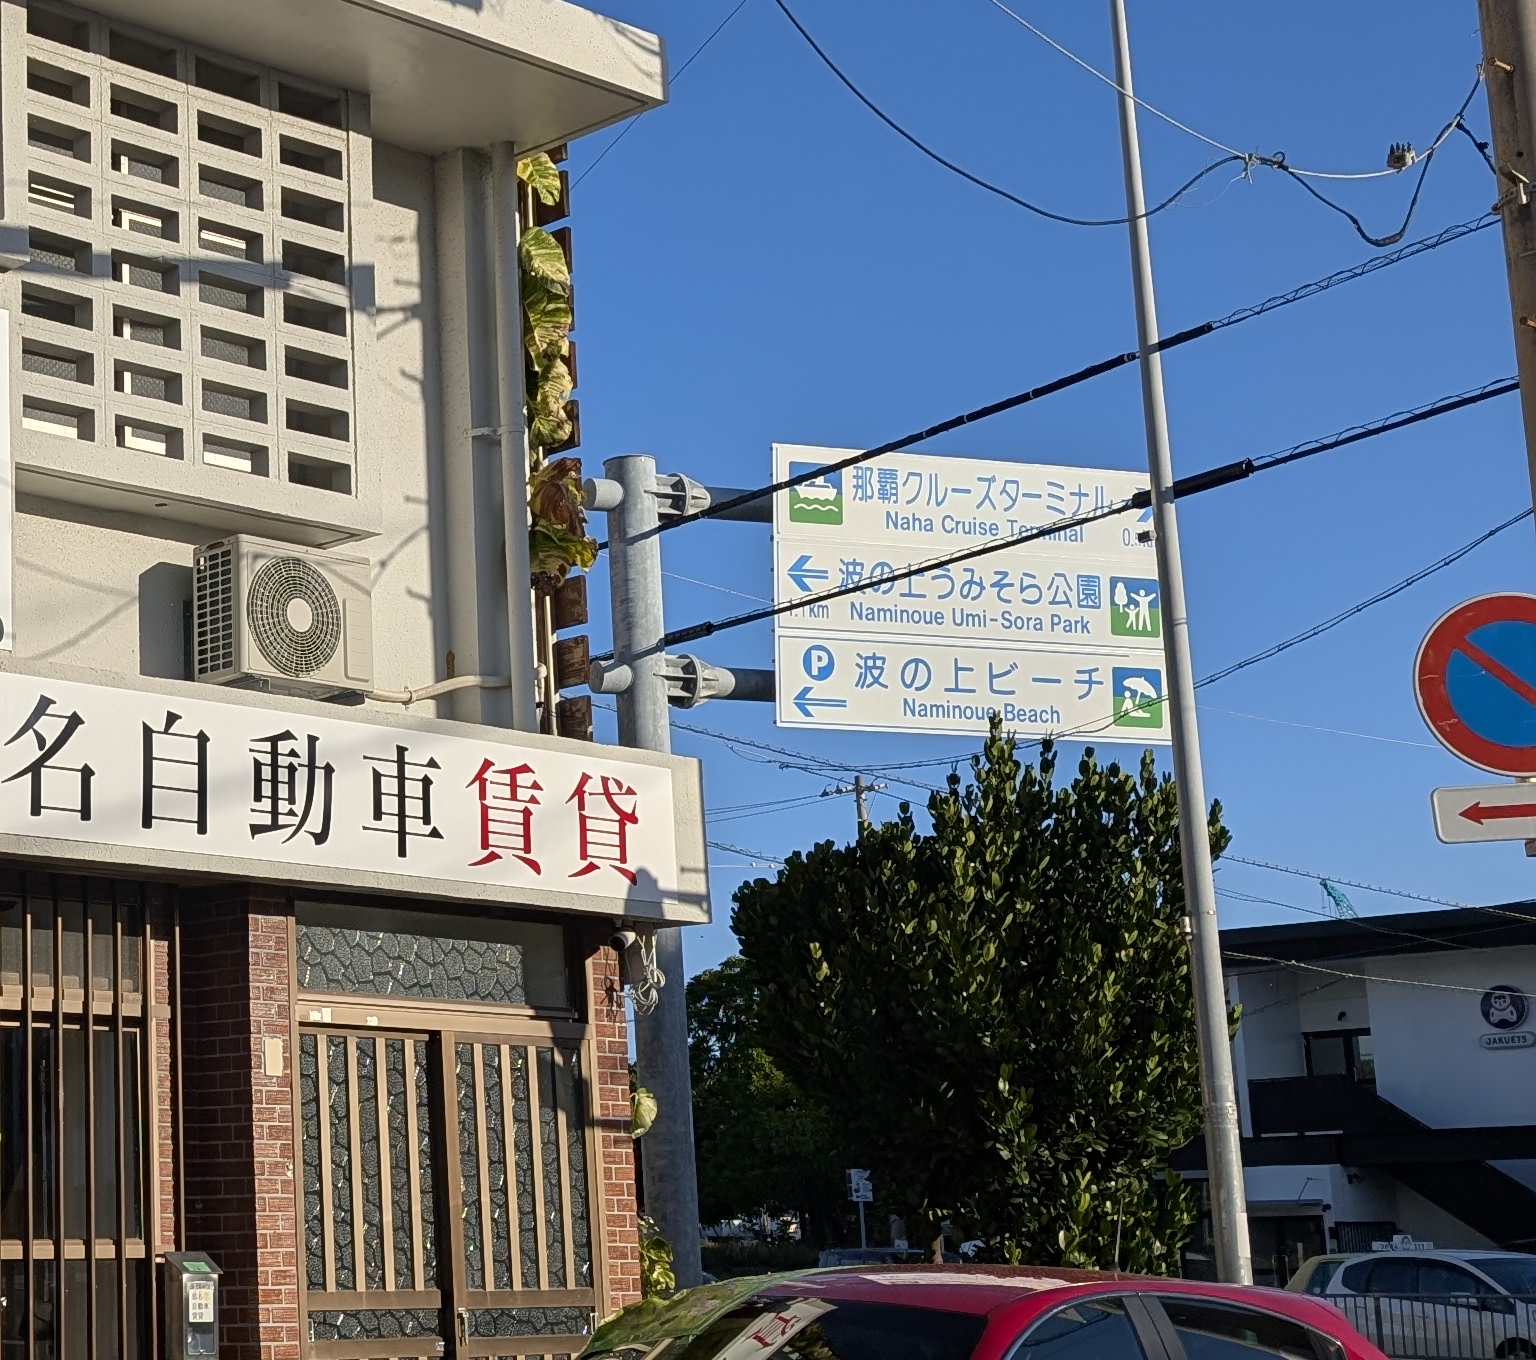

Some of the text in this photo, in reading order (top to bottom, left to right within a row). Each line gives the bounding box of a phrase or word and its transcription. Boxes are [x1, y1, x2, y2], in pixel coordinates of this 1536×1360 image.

[852, 466, 1116, 517] 那覇クルーズターミナル
[885, 511, 934, 533] Naha
[941, 514, 999, 536] Cruise
[838, 558, 1101, 610] 波の上うみそら公園
[850, 601, 945, 626] Naminoue
[952, 607, 1044, 632] Umi-Sora
[1050, 613, 1091, 635] Park
[855, 652, 1105, 700] 波の上ビーチ
[903, 698, 1061, 724] Naminoue Beach
[1485, 1034, 1528, 1046] JAKUETS
